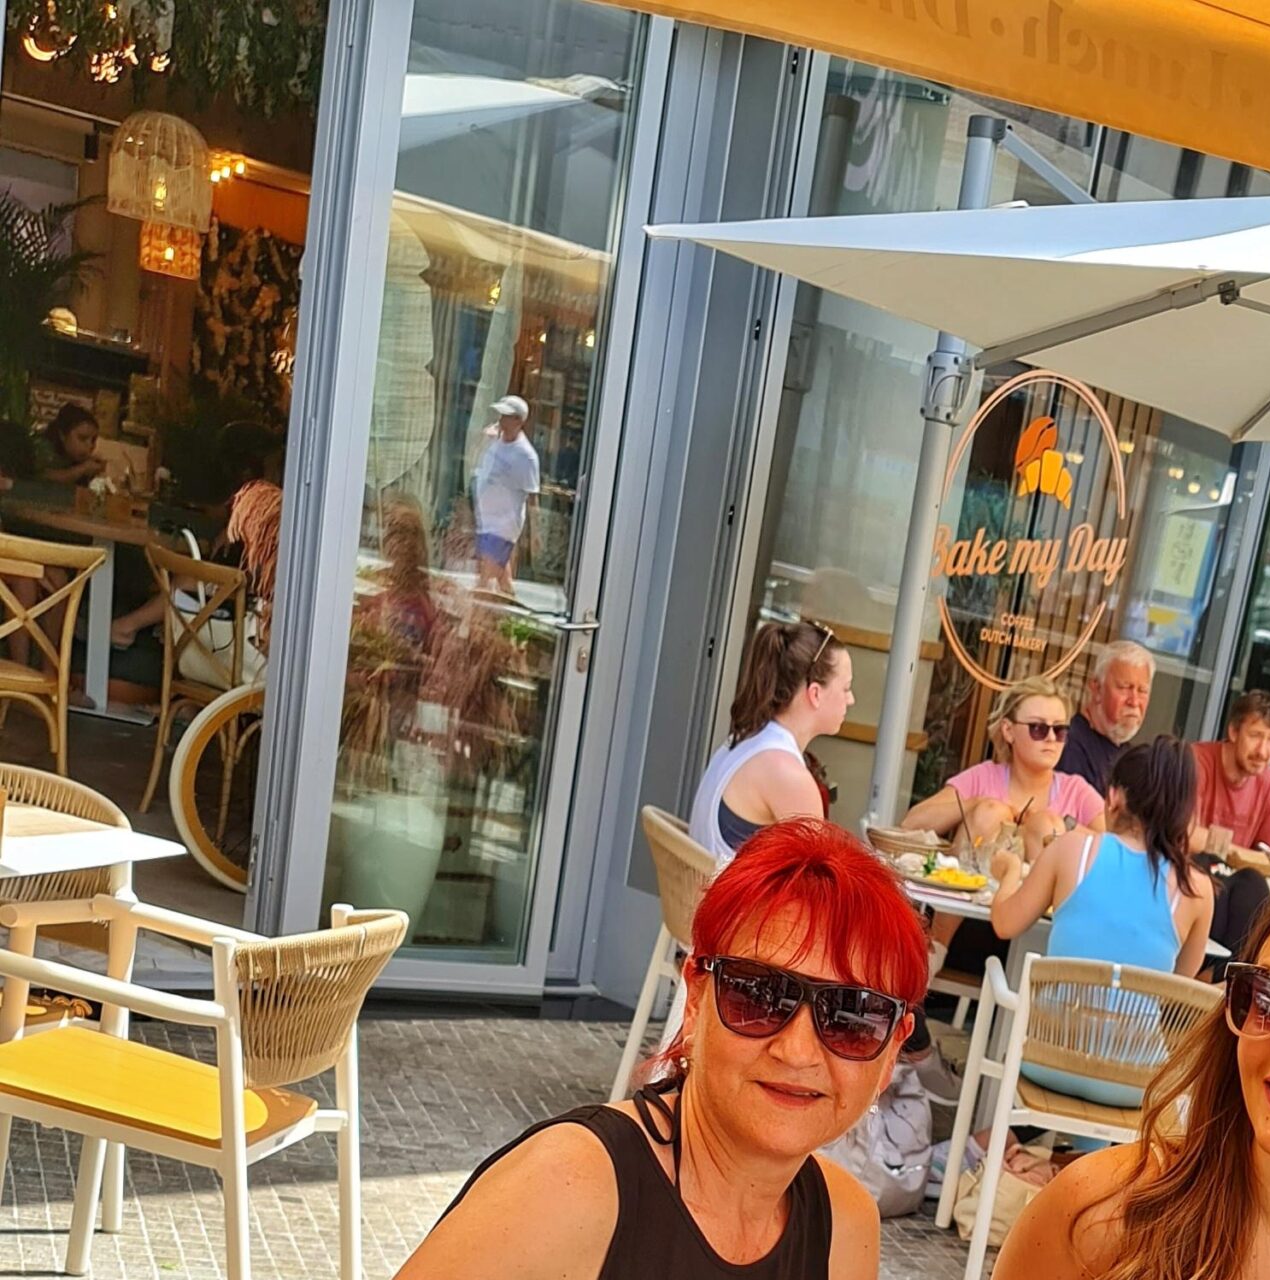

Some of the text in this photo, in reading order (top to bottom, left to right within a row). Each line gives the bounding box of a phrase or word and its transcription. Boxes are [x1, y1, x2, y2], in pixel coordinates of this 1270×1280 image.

[932, 523, 1007, 577] Bake
[1007, 538, 1062, 589] my
[1065, 522, 1127, 587] Day
[1001, 612, 1035, 631] COFFEE
[980, 627, 1049, 652] DUTCH BAKERY
